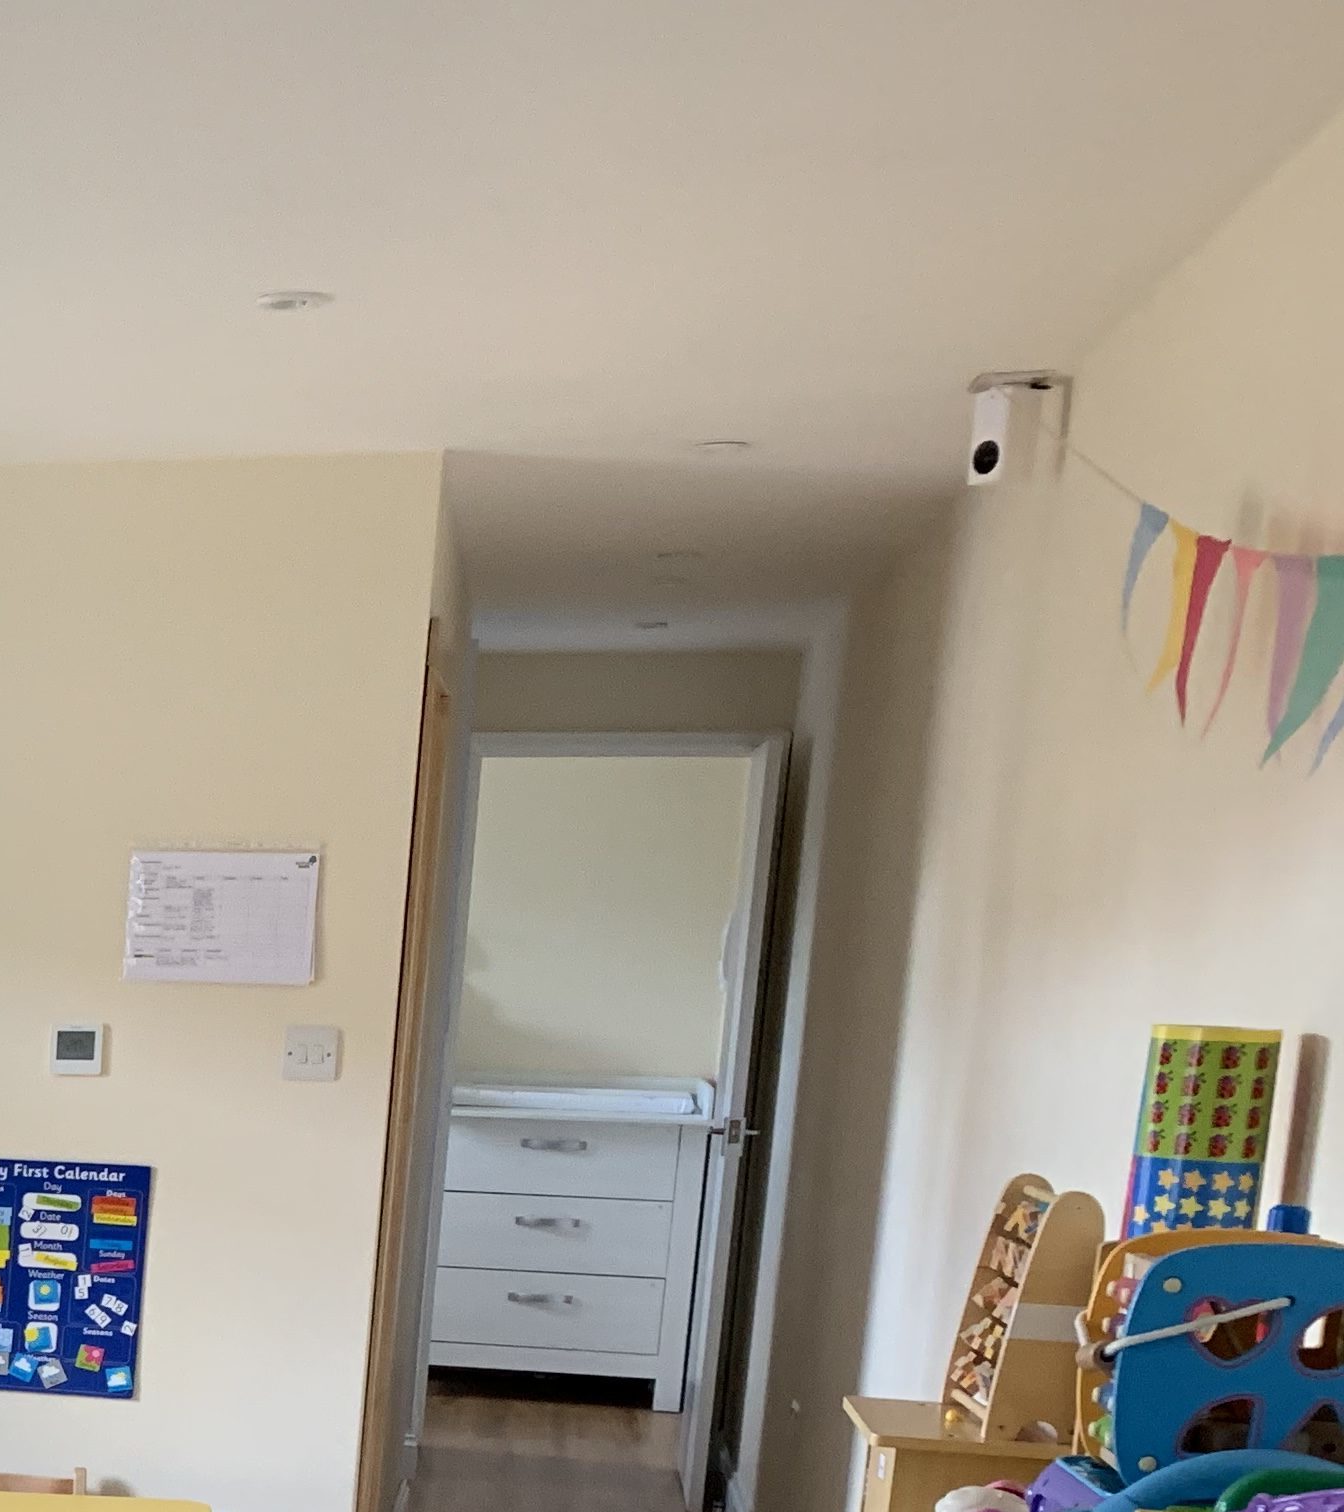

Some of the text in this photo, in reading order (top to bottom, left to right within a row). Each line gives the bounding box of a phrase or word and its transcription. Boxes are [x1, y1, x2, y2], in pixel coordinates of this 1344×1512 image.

[13, 1163, 50, 1178] First
[53, 1165, 126, 1182] Calendar
[43, 1181, 62, 1193] Day
[39, 1211, 62, 1221] Date
[33, 1240, 63, 1251] Month
[98, 1249, 126, 1259] Sunday
[28, 1268, 64, 1280] Weather
[78, 1288, 85, 1298] 5
[27, 1310, 58, 1321] Season
